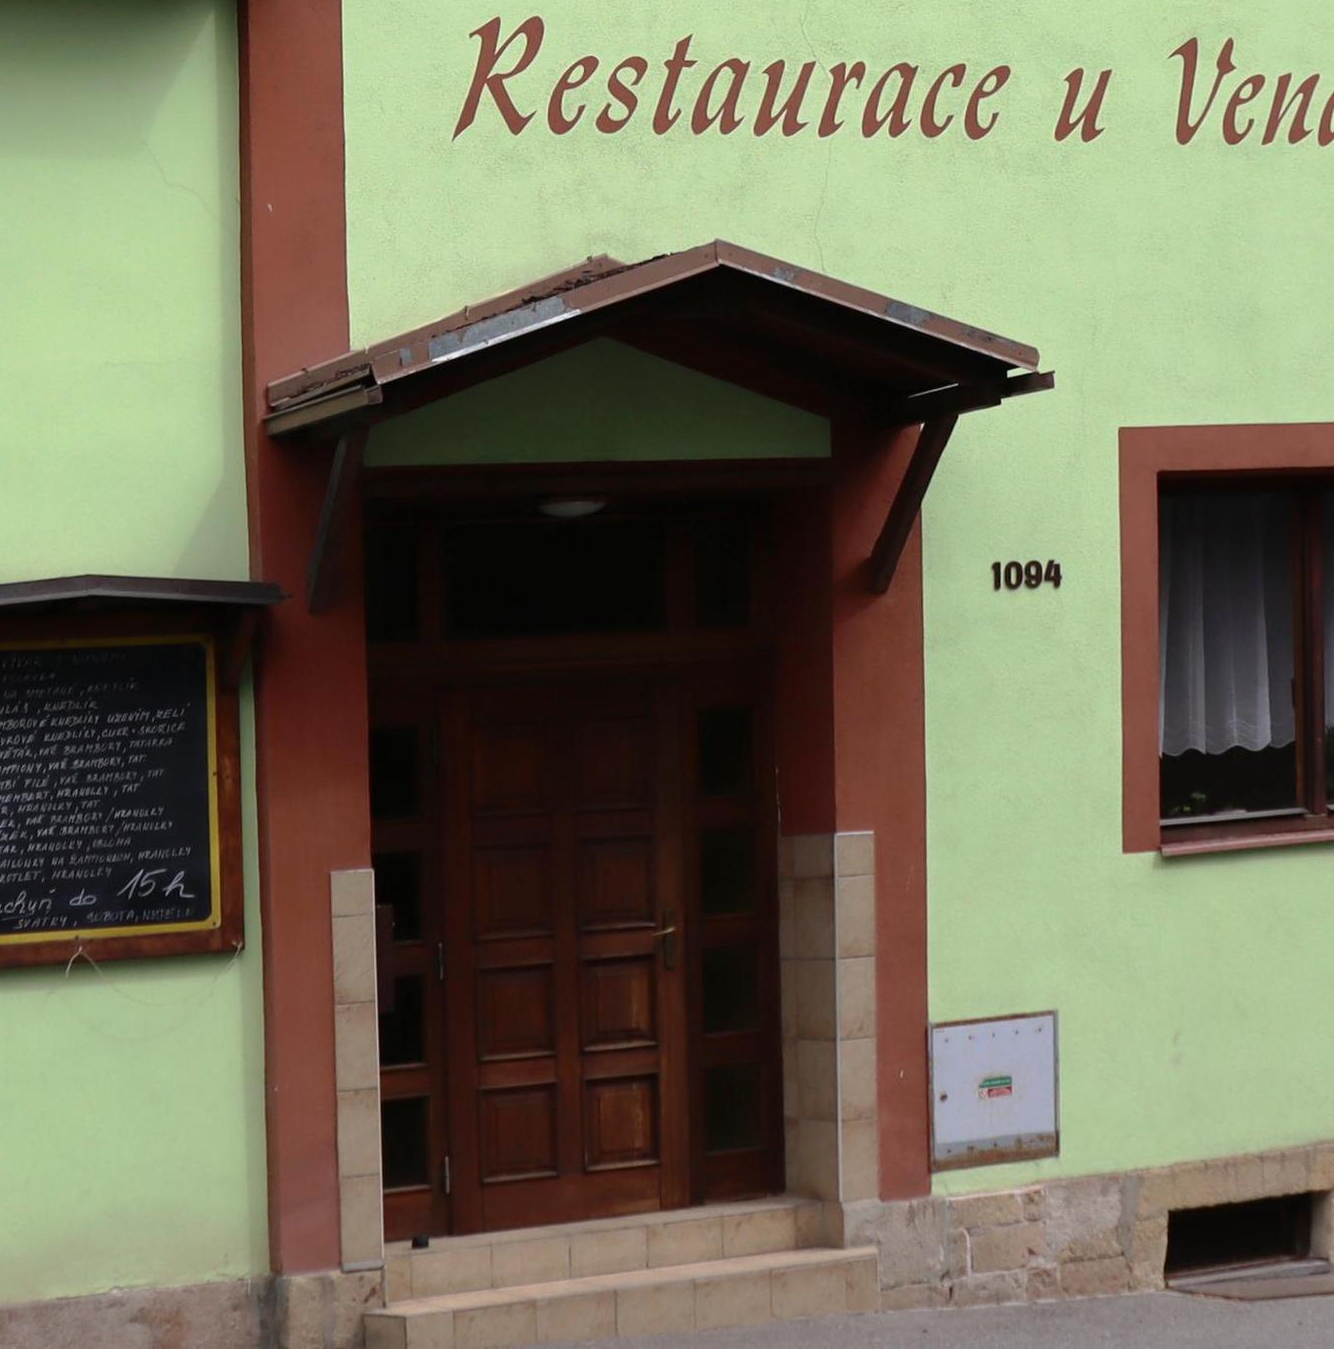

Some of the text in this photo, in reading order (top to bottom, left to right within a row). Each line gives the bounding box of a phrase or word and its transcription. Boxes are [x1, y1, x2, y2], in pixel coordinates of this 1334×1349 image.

[452, 15, 1012, 142] Restaurace
[1053, 66, 1111, 144] u
[991, 559, 1062, 591] 1094
[69, 888, 97, 906] do
[116, 868, 168, 900] 15
[162, 870, 196, 898] h
